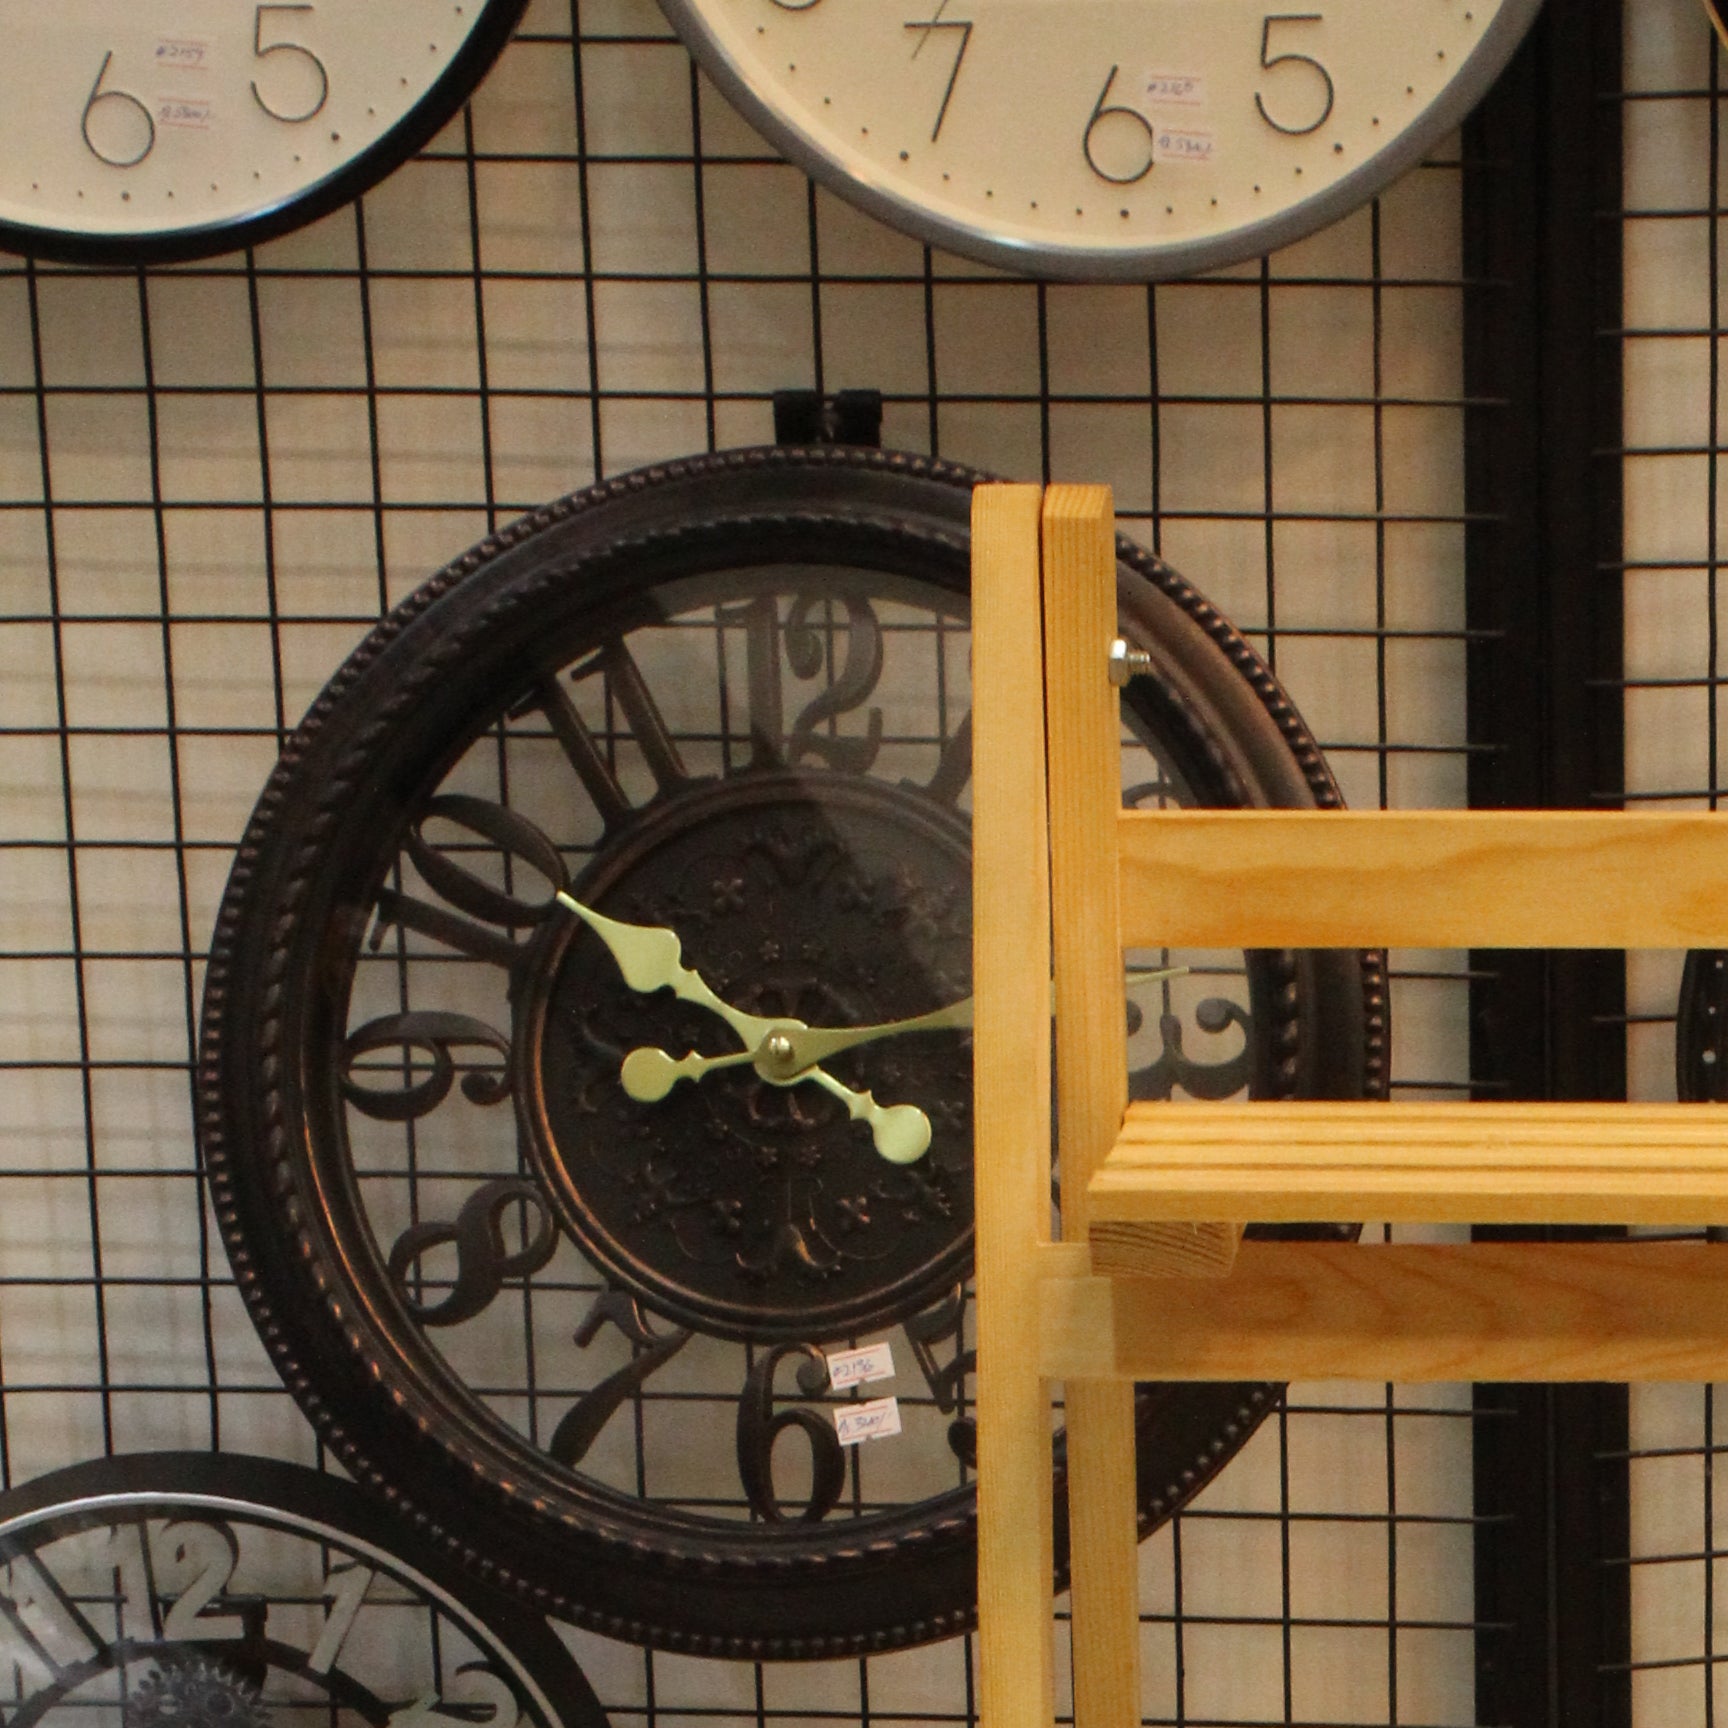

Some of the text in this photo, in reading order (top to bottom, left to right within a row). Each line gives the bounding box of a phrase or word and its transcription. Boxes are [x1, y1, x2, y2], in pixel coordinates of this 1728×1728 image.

[82, 50, 155, 168] 6
[251, 4, 329, 123] 5
[903, 20, 973, 143] 7
[1083, 64, 1155, 184] 6
[1255, 14, 1334, 136] 5
[508, 632, 700, 830] 11
[715, 592, 884, 774] 12
[369, 794, 572, 970] 10
[336, 1010, 516, 1122] 9
[387, 1178, 560, 1328] 8
[547, 1285, 692, 1468] 7
[737, 1342, 845, 1524] 6
[100, 1519, 245, 1641] 12
[308, 1561, 376, 1676] 1
